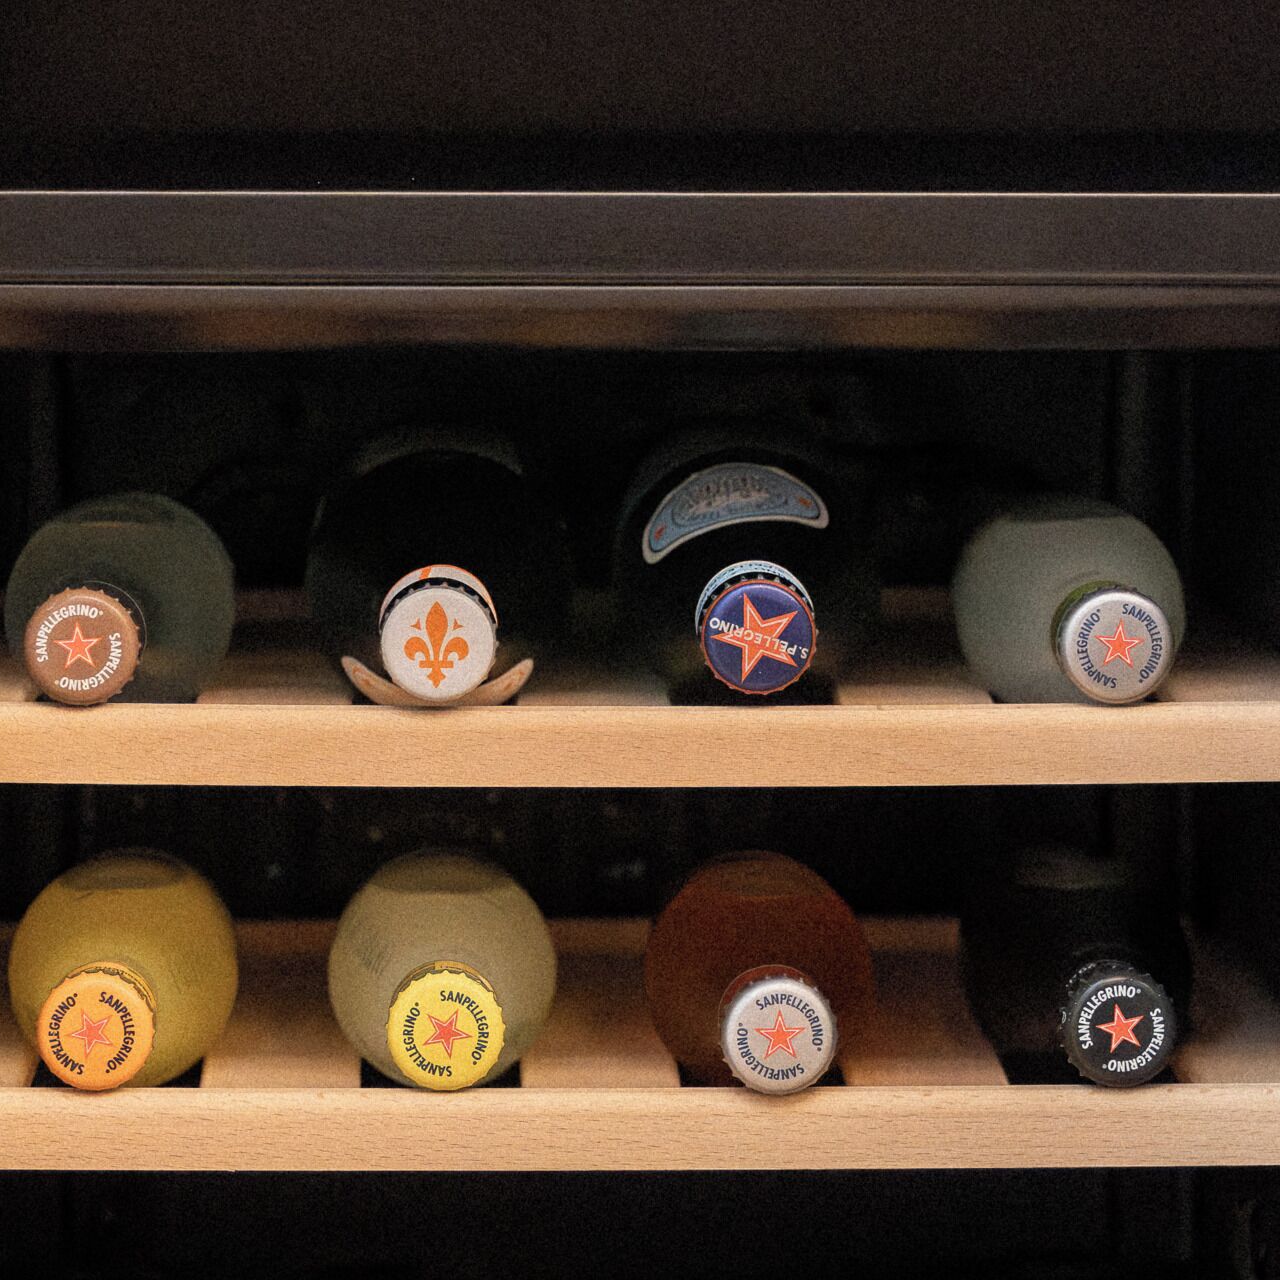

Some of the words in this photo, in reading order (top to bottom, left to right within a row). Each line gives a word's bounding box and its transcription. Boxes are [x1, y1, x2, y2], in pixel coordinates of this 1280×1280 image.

[36, 604, 98, 663] SANPELLEGRINO
[59, 632, 123, 691] SANPELLEGRINO
[1077, 612, 1117, 689] SANPELLEGRINO
[1122, 603, 1163, 680] SANPELLEGRINO
[48, 996, 85, 1075] SANPELLEGRINO
[99, 991, 135, 1071] SANPELLEGRINO
[403, 1007, 452, 1077] SANPELLEGRINO
[440, 990, 489, 1061] SANPELLEGRINO
[756, 993, 823, 1046] SANPELLEGRINO
[1078, 985, 1136, 1050] SANPELLEGRINO
[1108, 1007, 1165, 1073] SANPELLEGRINO
[737, 1028, 805, 1081] SANPELLEGRINO
